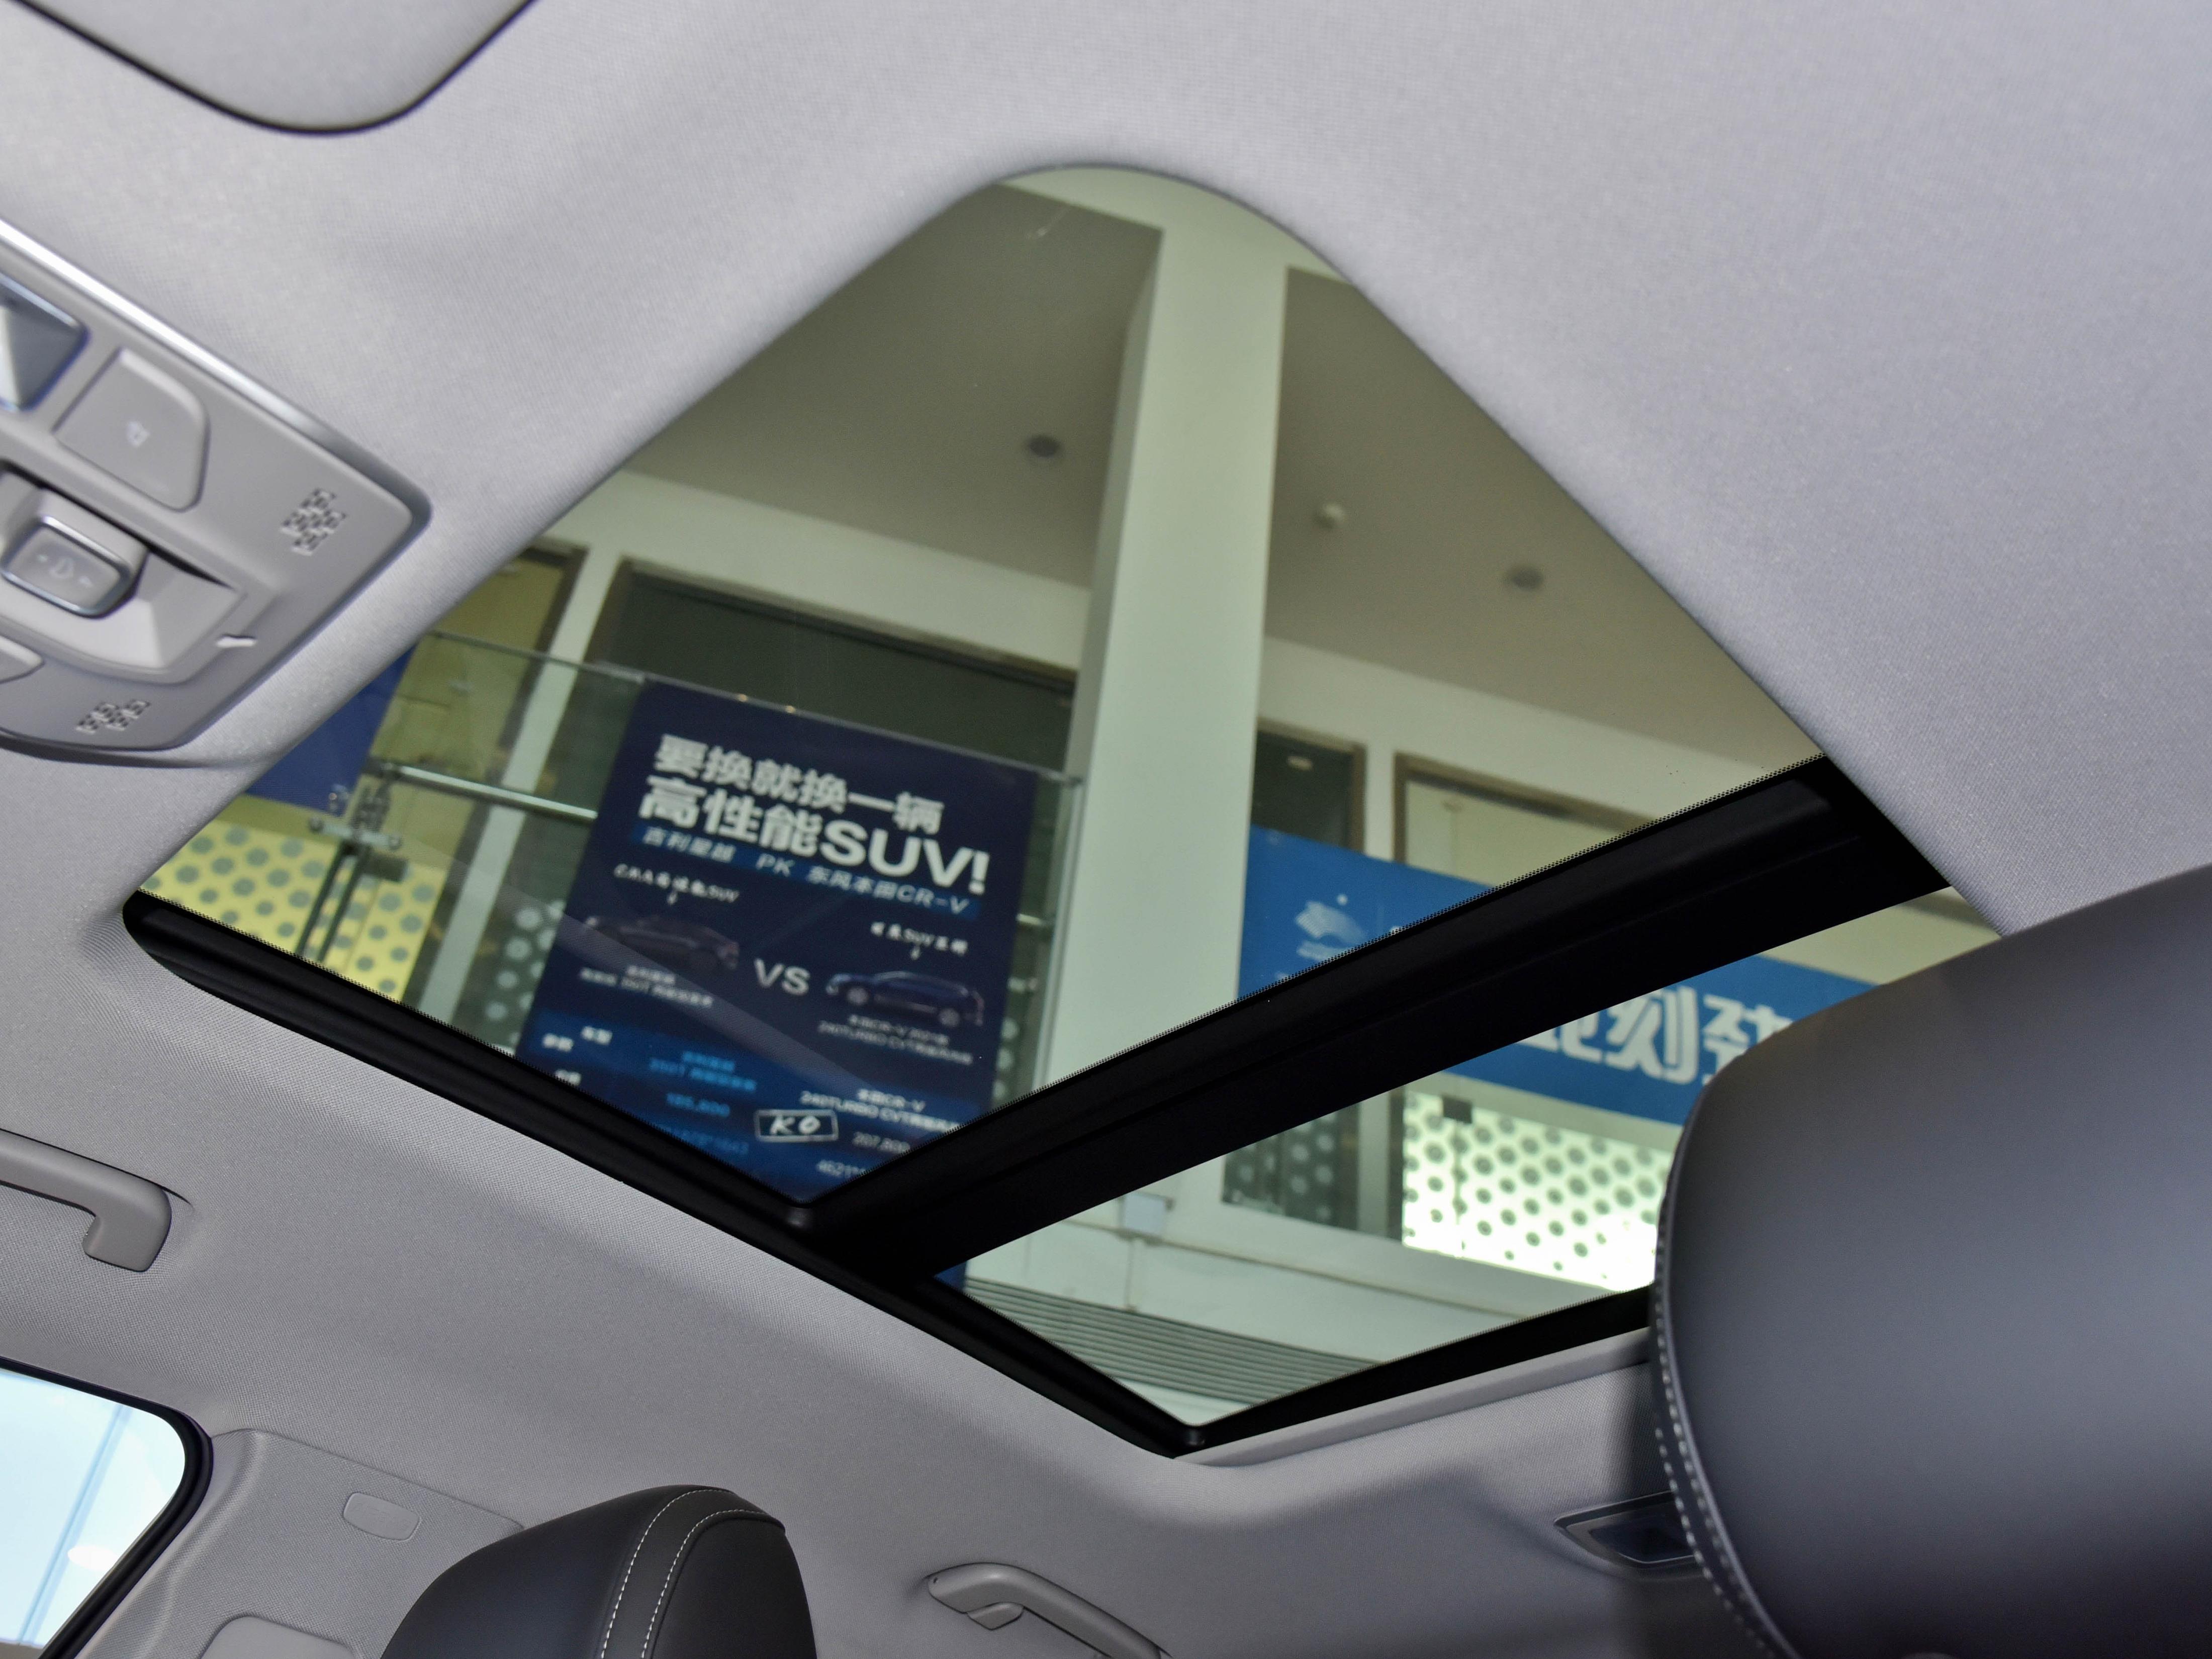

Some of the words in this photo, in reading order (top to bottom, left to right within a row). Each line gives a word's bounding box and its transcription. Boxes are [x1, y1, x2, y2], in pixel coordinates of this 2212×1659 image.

[655, 734, 944, 835] 要换就换一辆
[638, 775, 991, 894] 高性能SUV!
[756, 853, 796, 878] PK
[754, 958, 811, 996] VS
